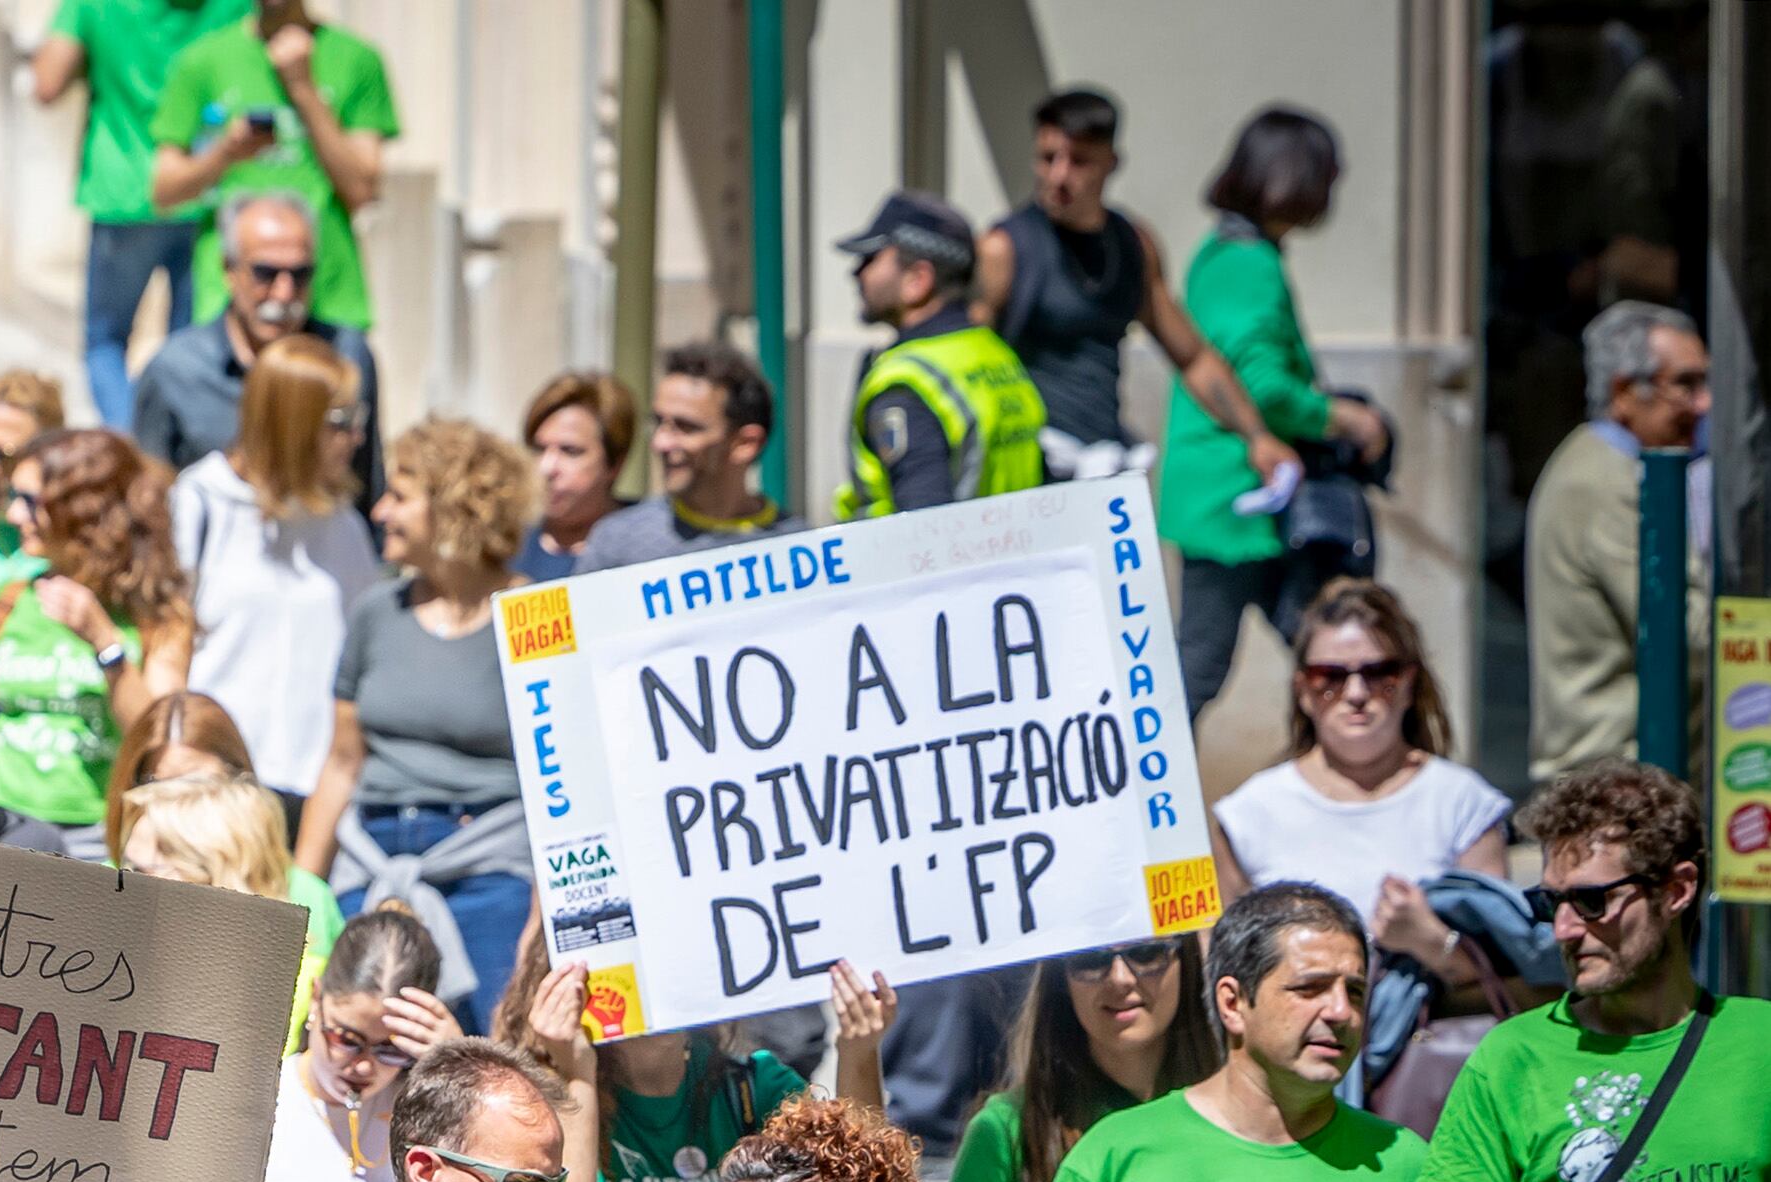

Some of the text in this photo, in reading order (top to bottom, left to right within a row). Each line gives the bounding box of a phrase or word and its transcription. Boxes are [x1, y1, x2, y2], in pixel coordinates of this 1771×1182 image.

[506, 586, 569, 632] JO FAIG
[642, 538, 851, 618] MATILDE
[509, 614, 573, 658] VAGA!
[1108, 497, 1177, 829] SALVADOR
[640, 593, 1051, 762] NO A LA
[665, 689, 1127, 877] PRIVATITZACIÓ
[548, 843, 611, 874] VAGA
[1151, 858, 1213, 900] JO FAIG
[711, 831, 1056, 997] DE L'FP
[1153, 886, 1219, 928] VAGA!
